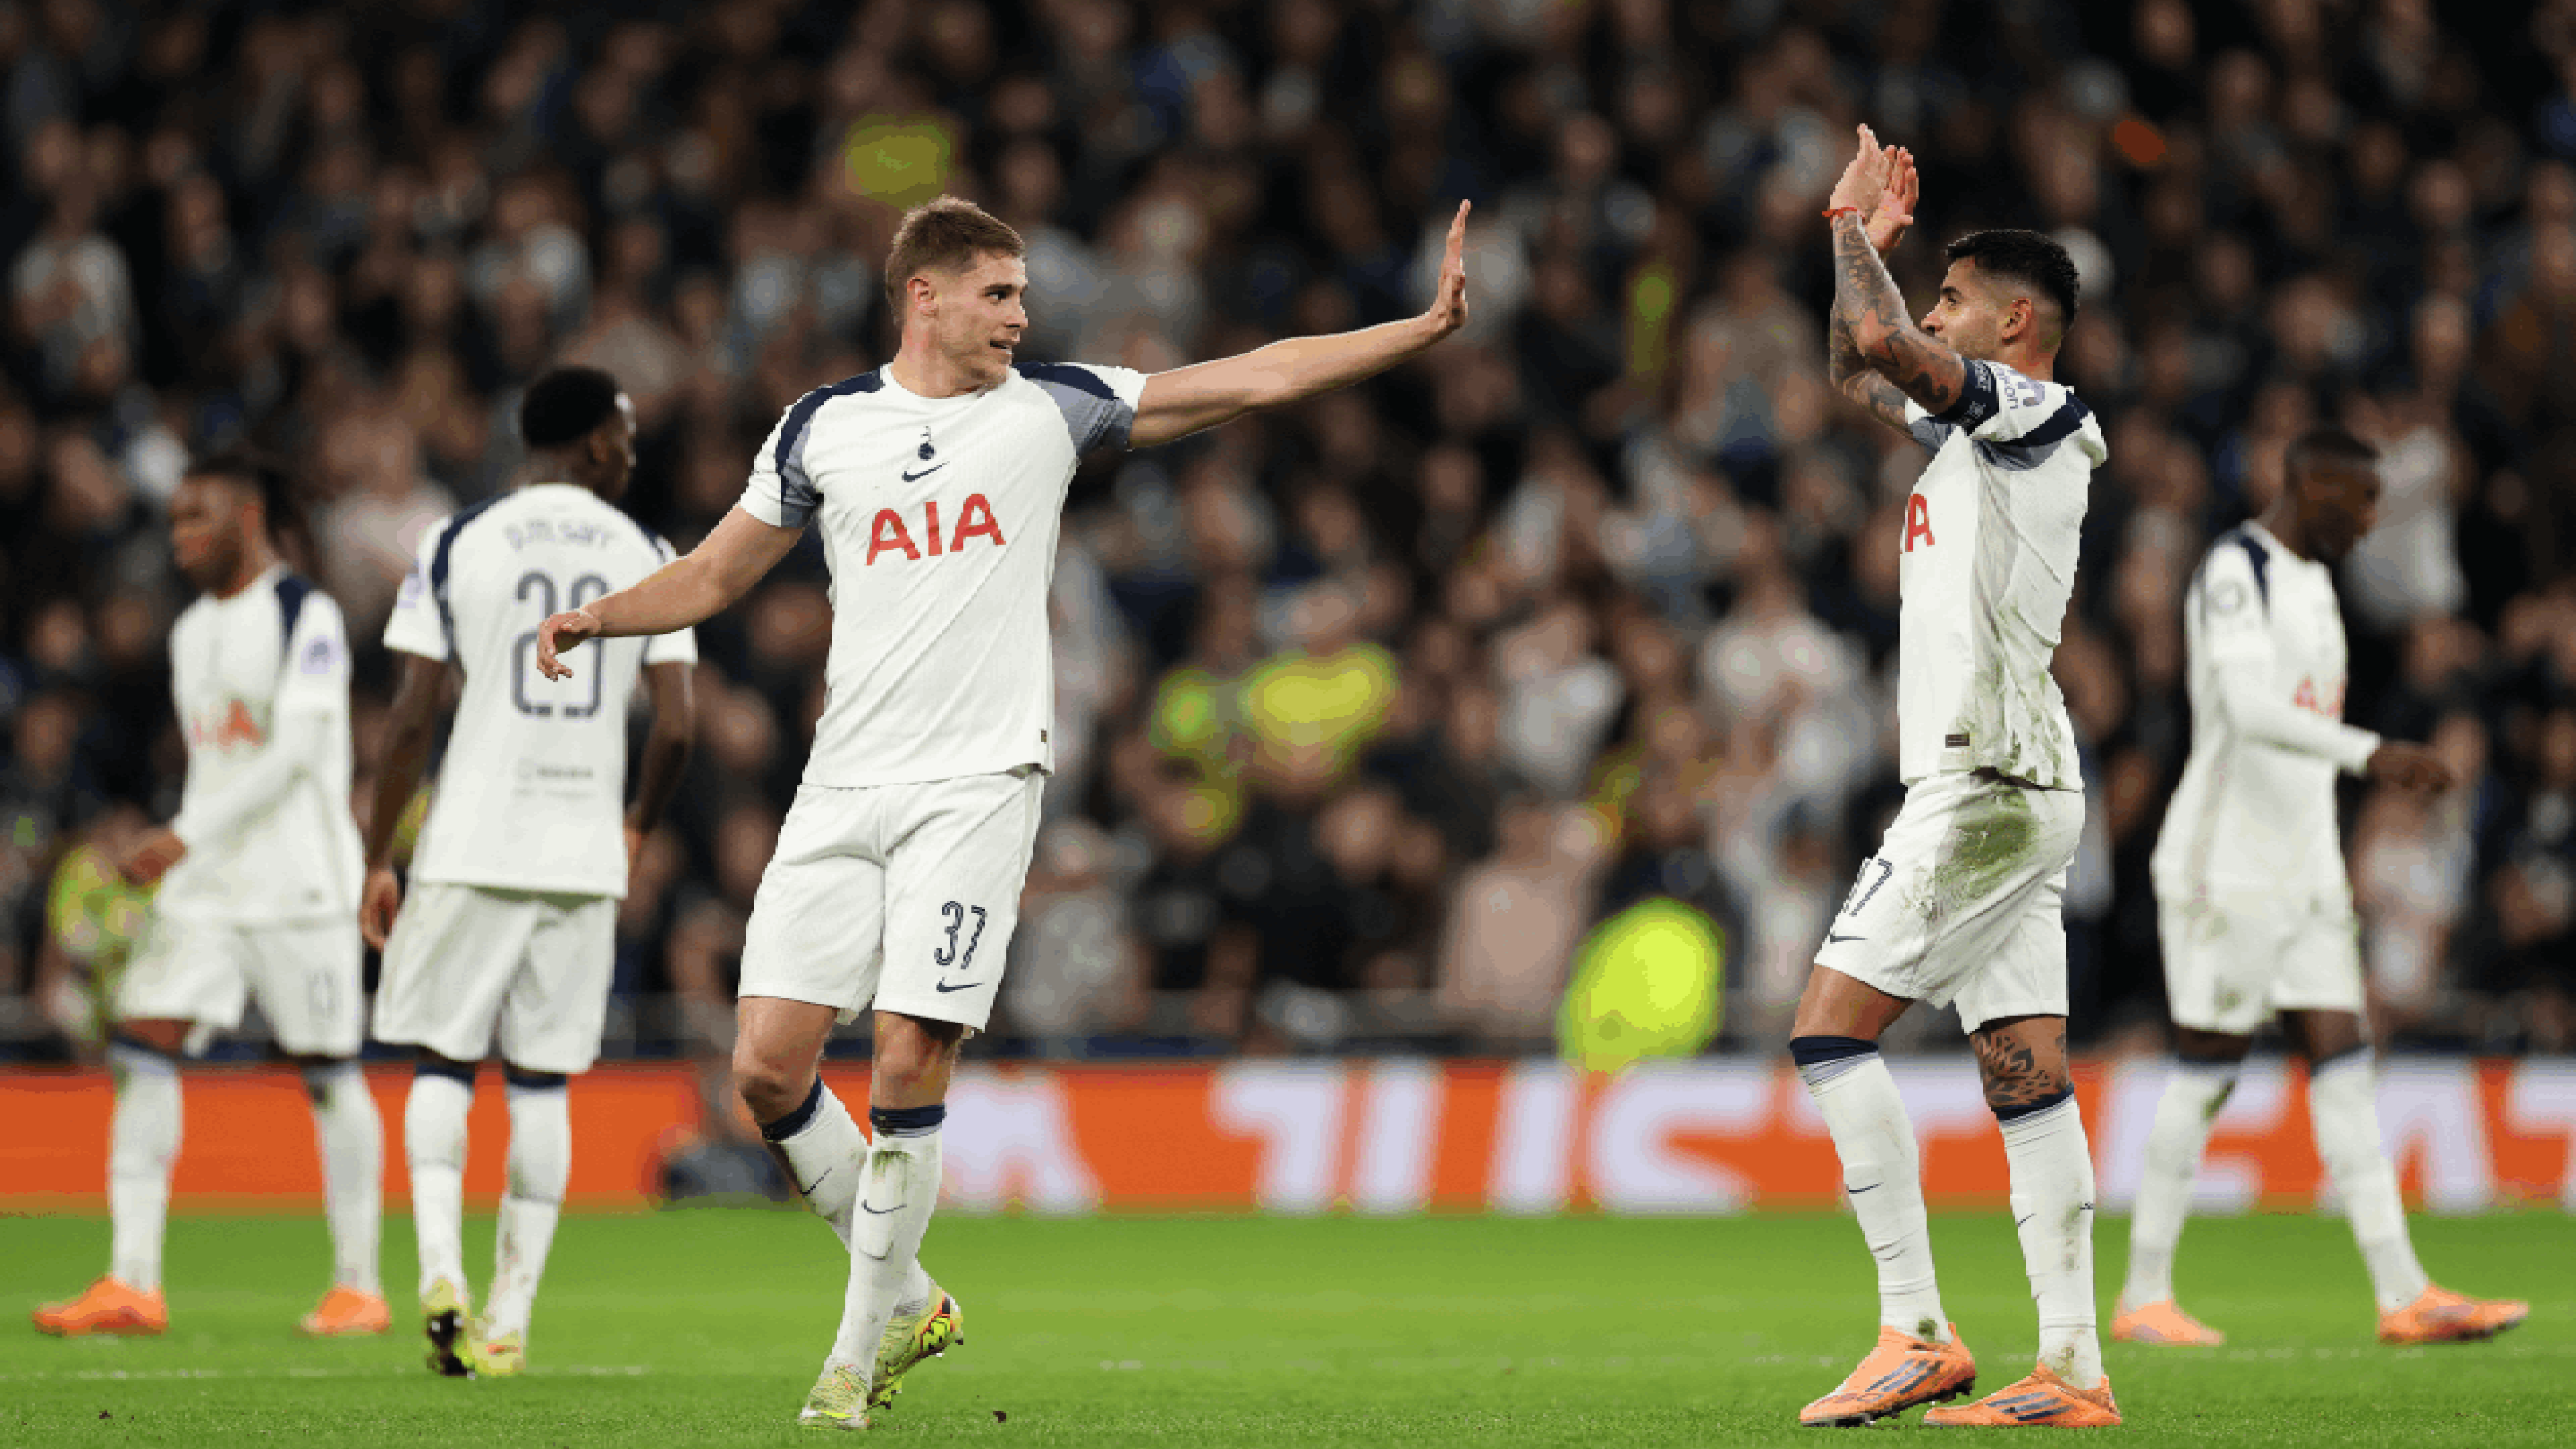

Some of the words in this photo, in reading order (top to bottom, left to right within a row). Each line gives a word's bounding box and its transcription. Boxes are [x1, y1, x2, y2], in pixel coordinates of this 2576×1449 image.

[865, 493, 1007, 566] AIA
[1900, 492, 1935, 553] A
[933, 900, 988, 970] 37
